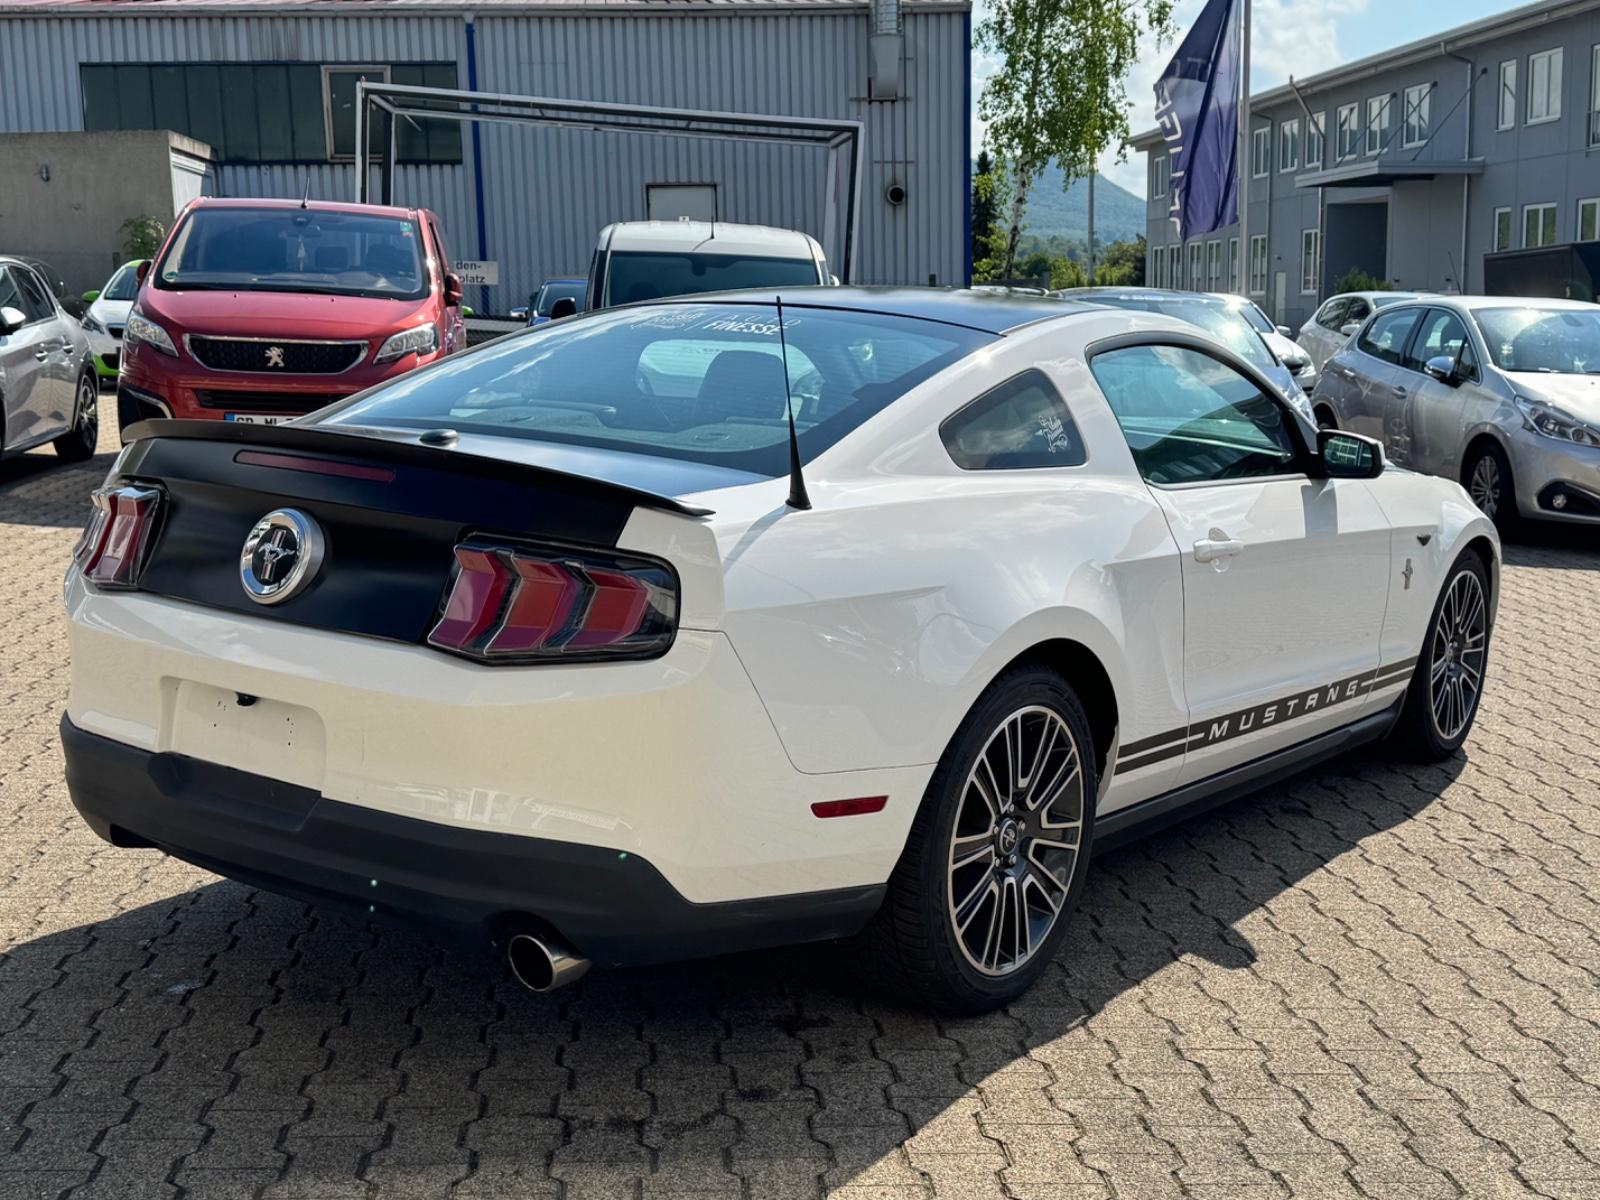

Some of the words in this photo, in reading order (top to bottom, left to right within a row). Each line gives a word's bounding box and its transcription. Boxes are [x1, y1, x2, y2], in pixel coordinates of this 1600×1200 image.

[455, 260, 482, 271] den-
[457, 273, 486, 285] platz
[703, 319, 788, 336] FINESSE
[1208, 679, 1359, 741] MUSTANG
